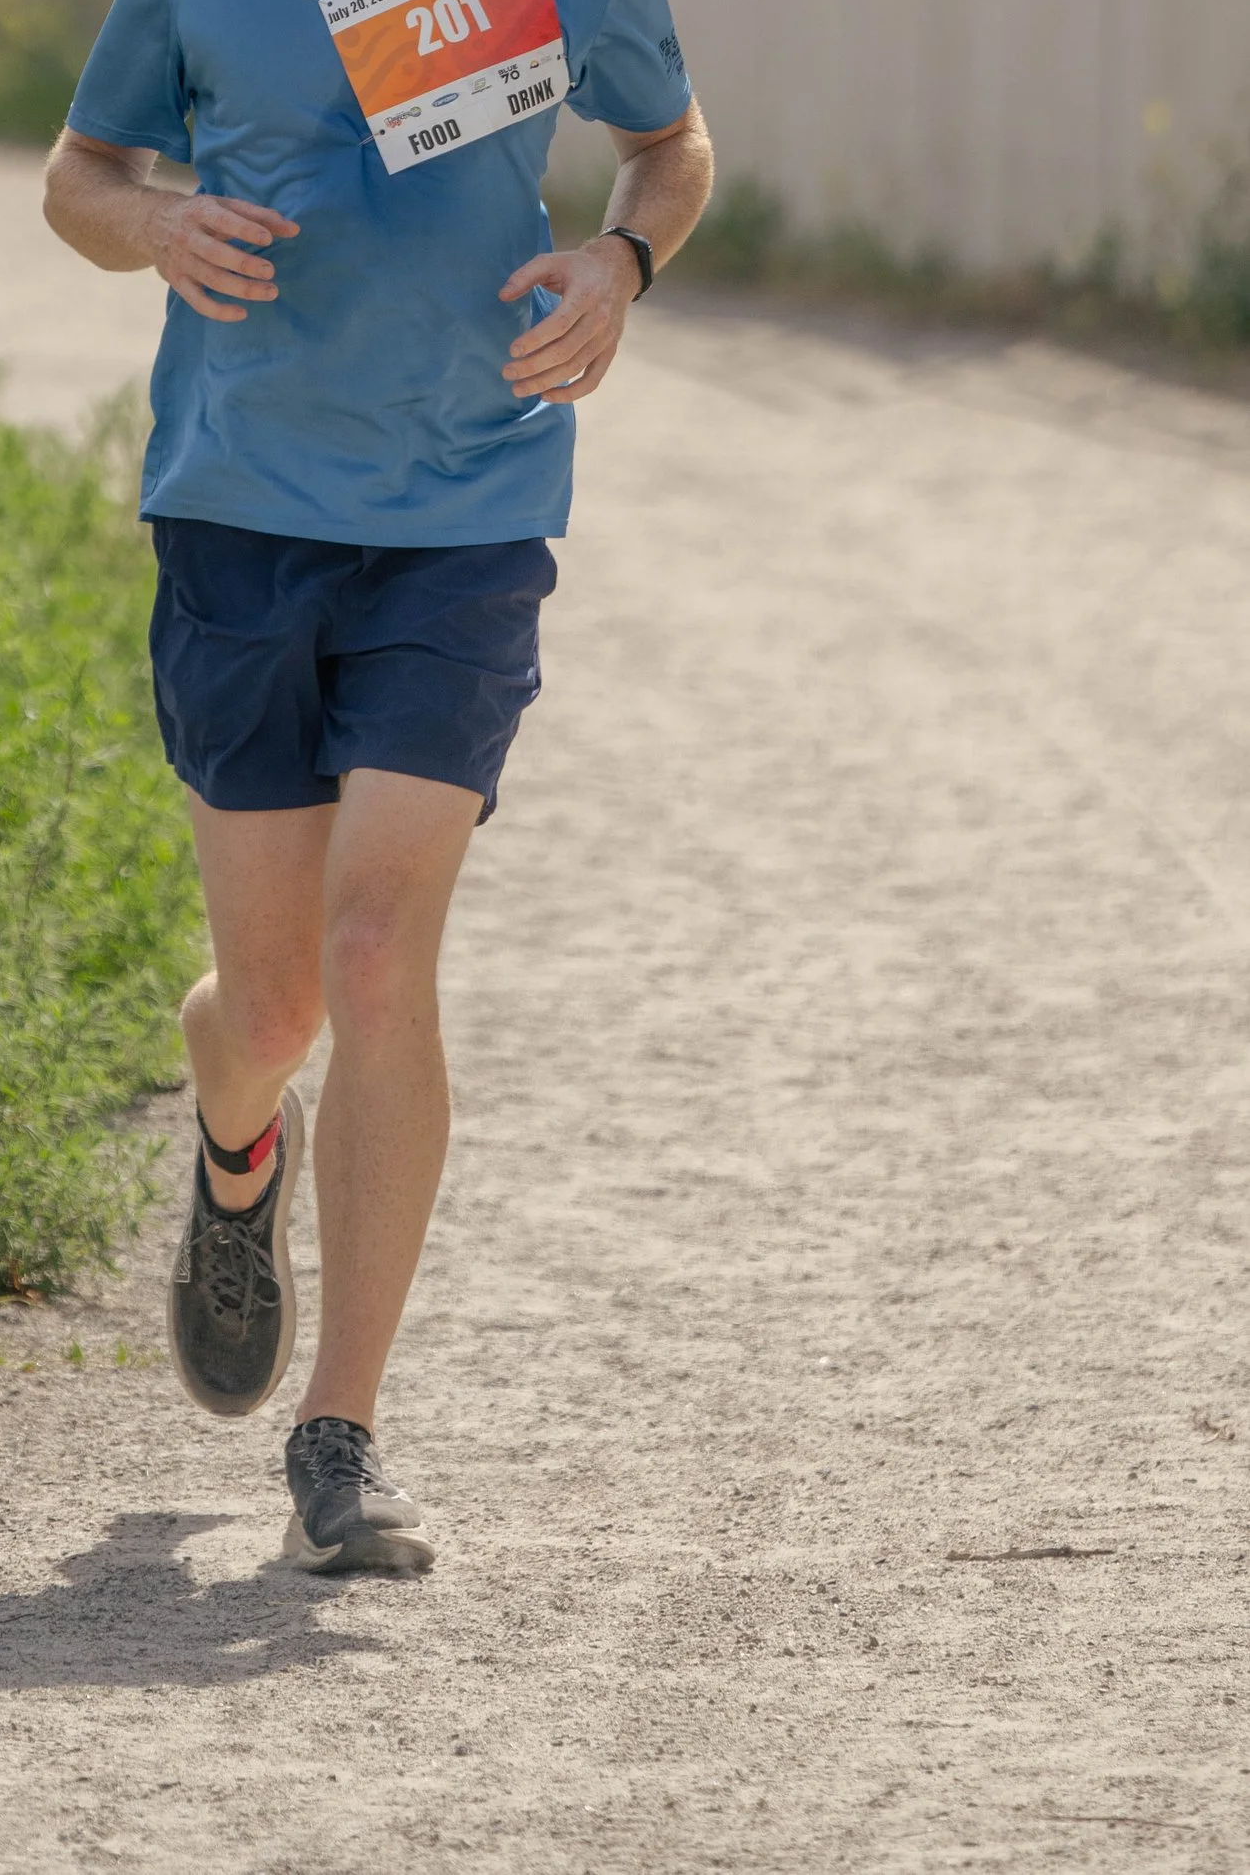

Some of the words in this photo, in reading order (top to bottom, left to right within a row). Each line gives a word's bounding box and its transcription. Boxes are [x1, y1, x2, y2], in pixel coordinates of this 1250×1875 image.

[328, 7, 350, 24] July
[498, 64, 518, 76] BLUE
[500, 70, 520, 84] 70
[506, 77, 554, 116] DRINK
[407, 118, 461, 155] FOOD
